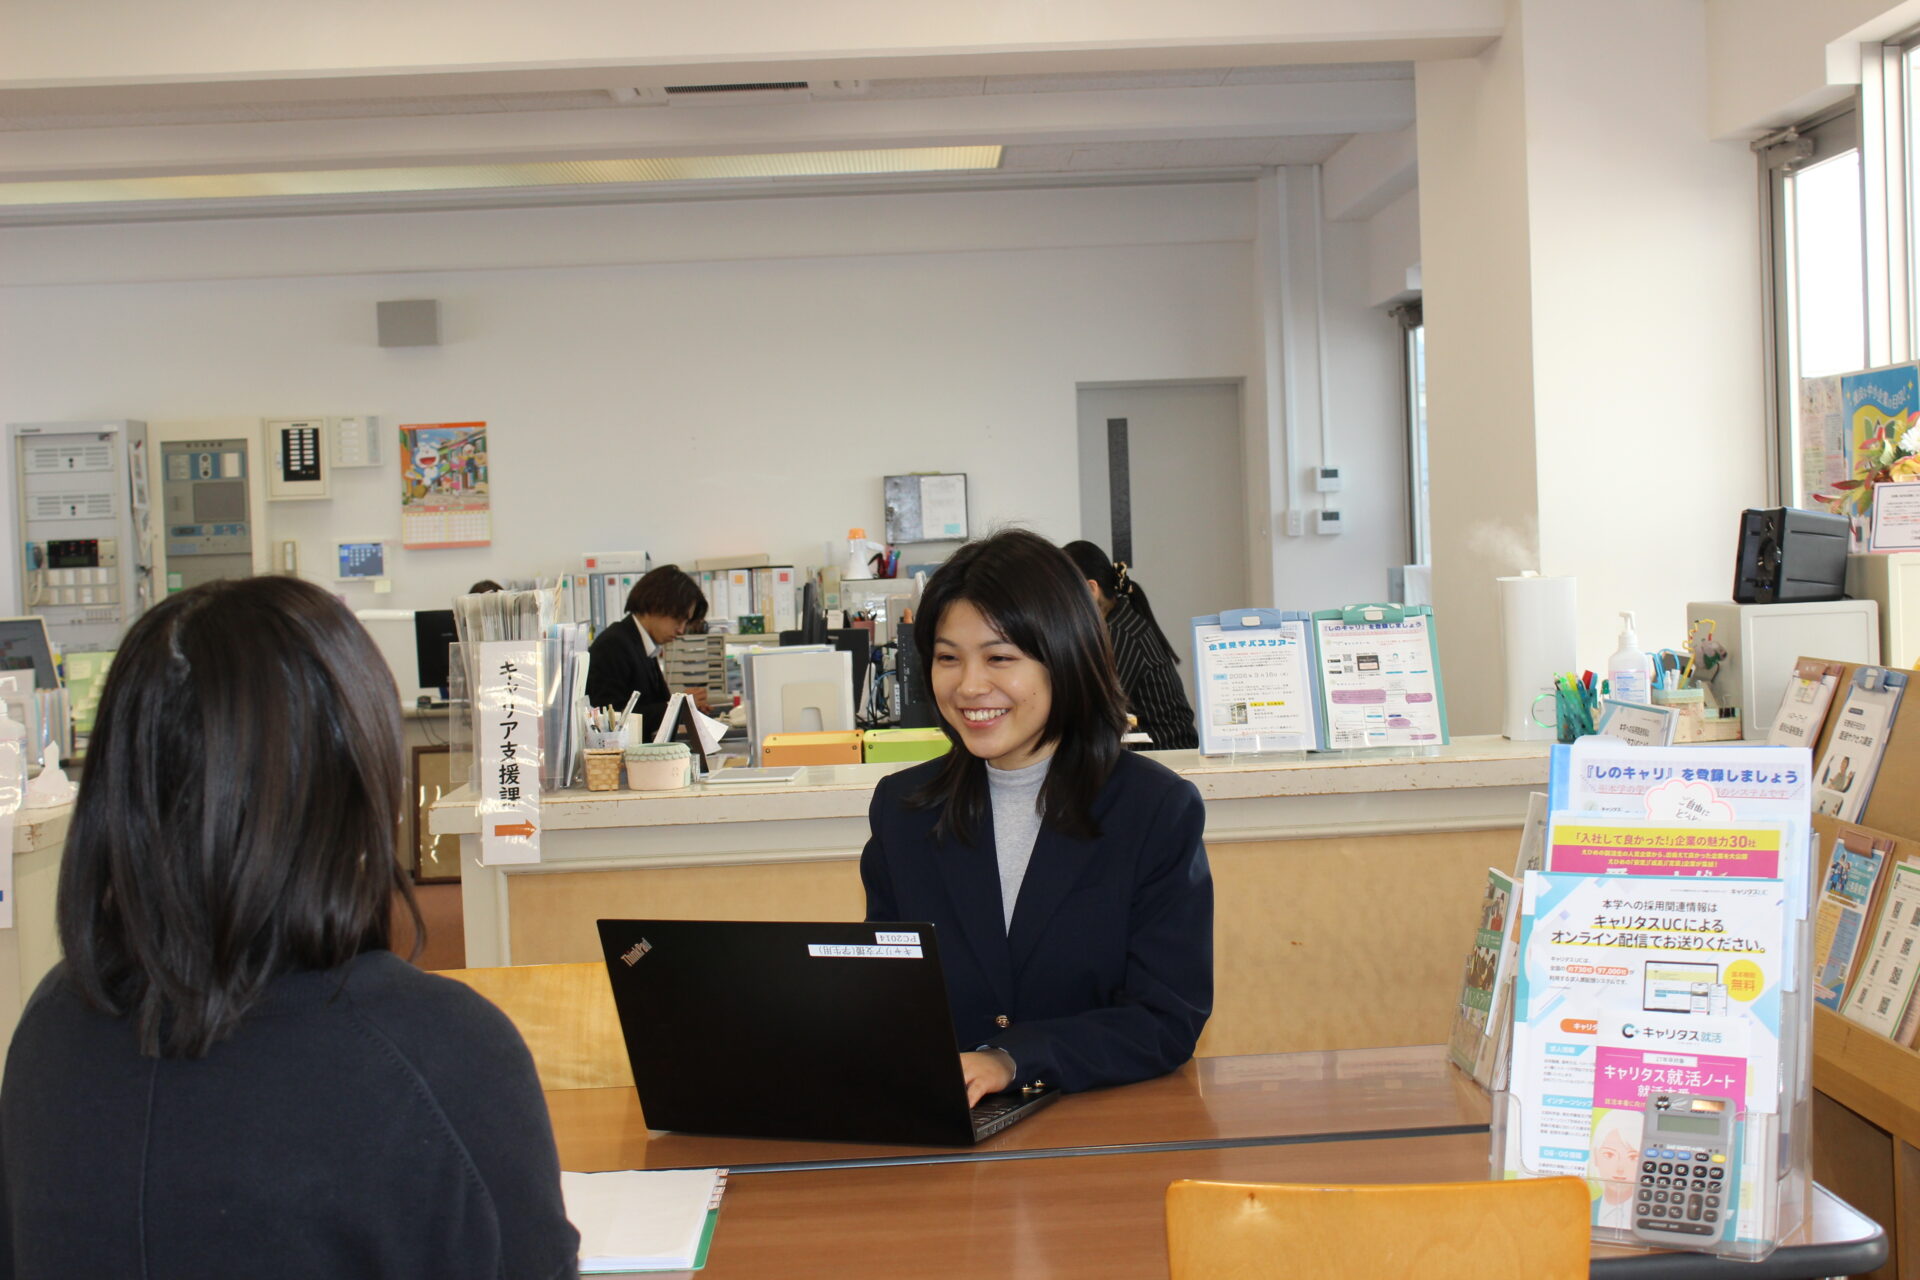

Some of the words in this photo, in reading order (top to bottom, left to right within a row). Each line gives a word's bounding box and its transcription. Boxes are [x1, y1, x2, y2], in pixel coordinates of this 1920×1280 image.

[1209, 640, 1296, 651] 企業見学バスツアー
[499, 661, 521, 807] キャリア支援課
[1602, 900, 1717, 913] 本学への採用関連情報は
[1594, 914, 1724, 933] キャリタスUCによる
[879, 935, 917, 943] PC2014
[1551, 931, 1766, 953] オンライン配信でお送りください。
[620, 937, 652, 967] ThinkPad
[1731, 979, 1756, 992] 無料
[1643, 1027, 1722, 1044] キャリタス就活
[1604, 1065, 1736, 1089] キャリタス就活ノート
